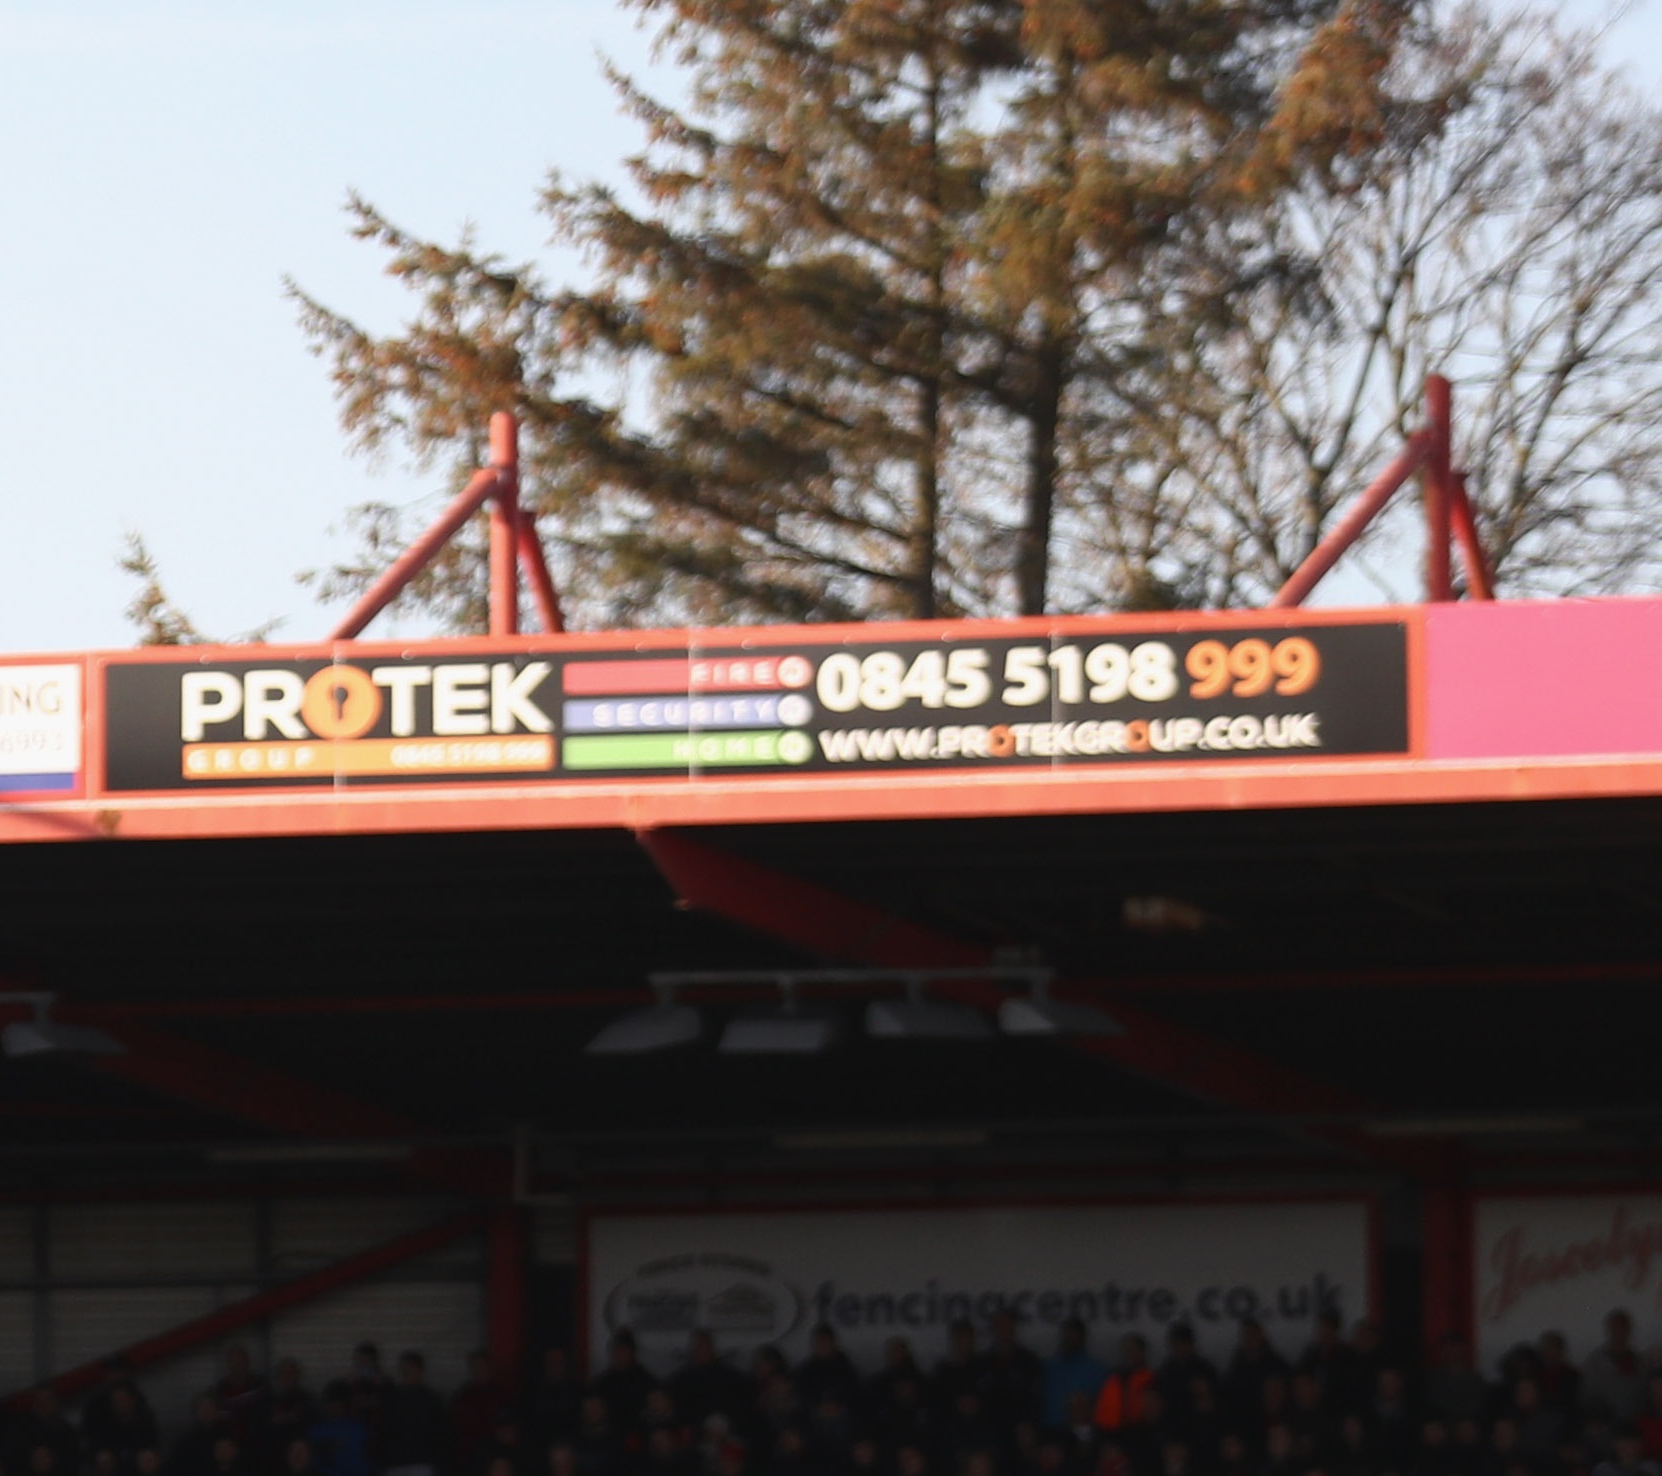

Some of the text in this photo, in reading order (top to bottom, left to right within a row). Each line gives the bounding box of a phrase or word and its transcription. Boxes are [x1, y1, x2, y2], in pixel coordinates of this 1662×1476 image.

[816, 636, 1321, 711] 0845 5198 999
[180, 659, 555, 742] PROTEK
[593, 699, 774, 727] SECURITY
[187, 747, 314, 772] GROUP
[819, 713, 1322, 762] WWW.PROTEKGROUP.CO.UK
[814, 1273, 1341, 1325] fencingcentre.co.uk
